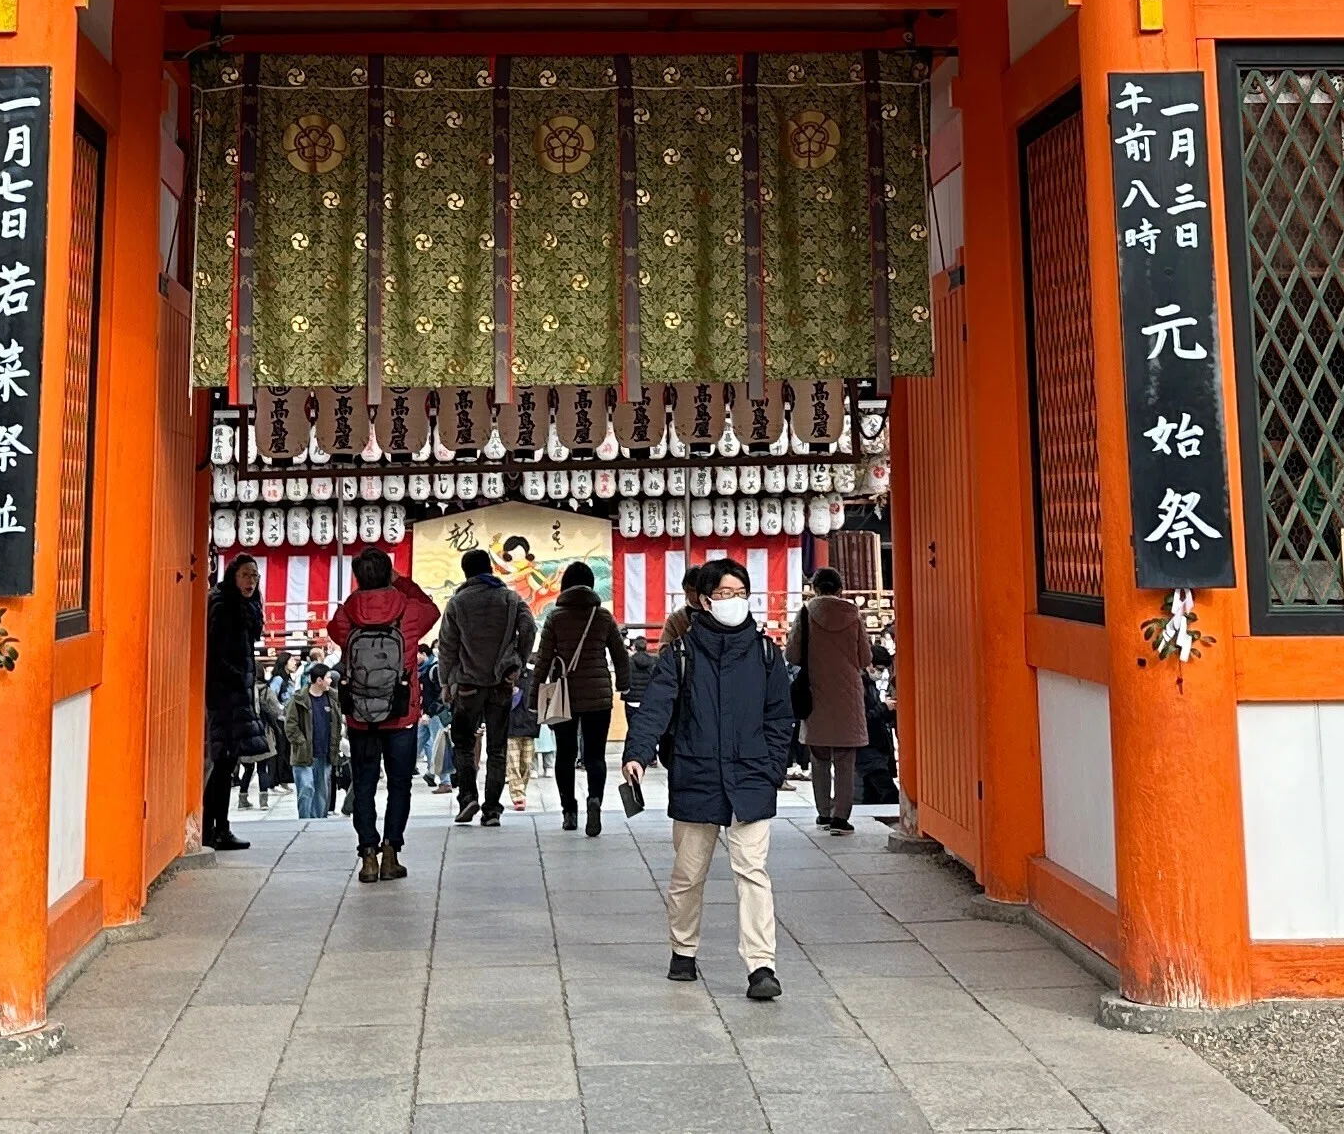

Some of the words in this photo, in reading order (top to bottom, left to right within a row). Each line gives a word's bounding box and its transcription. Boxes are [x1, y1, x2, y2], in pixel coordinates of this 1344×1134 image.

[1114, 81, 1161, 255] 午前八時
[1160, 101, 1207, 248] 一月三日
[1141, 304, 1223, 559] 元始祭
